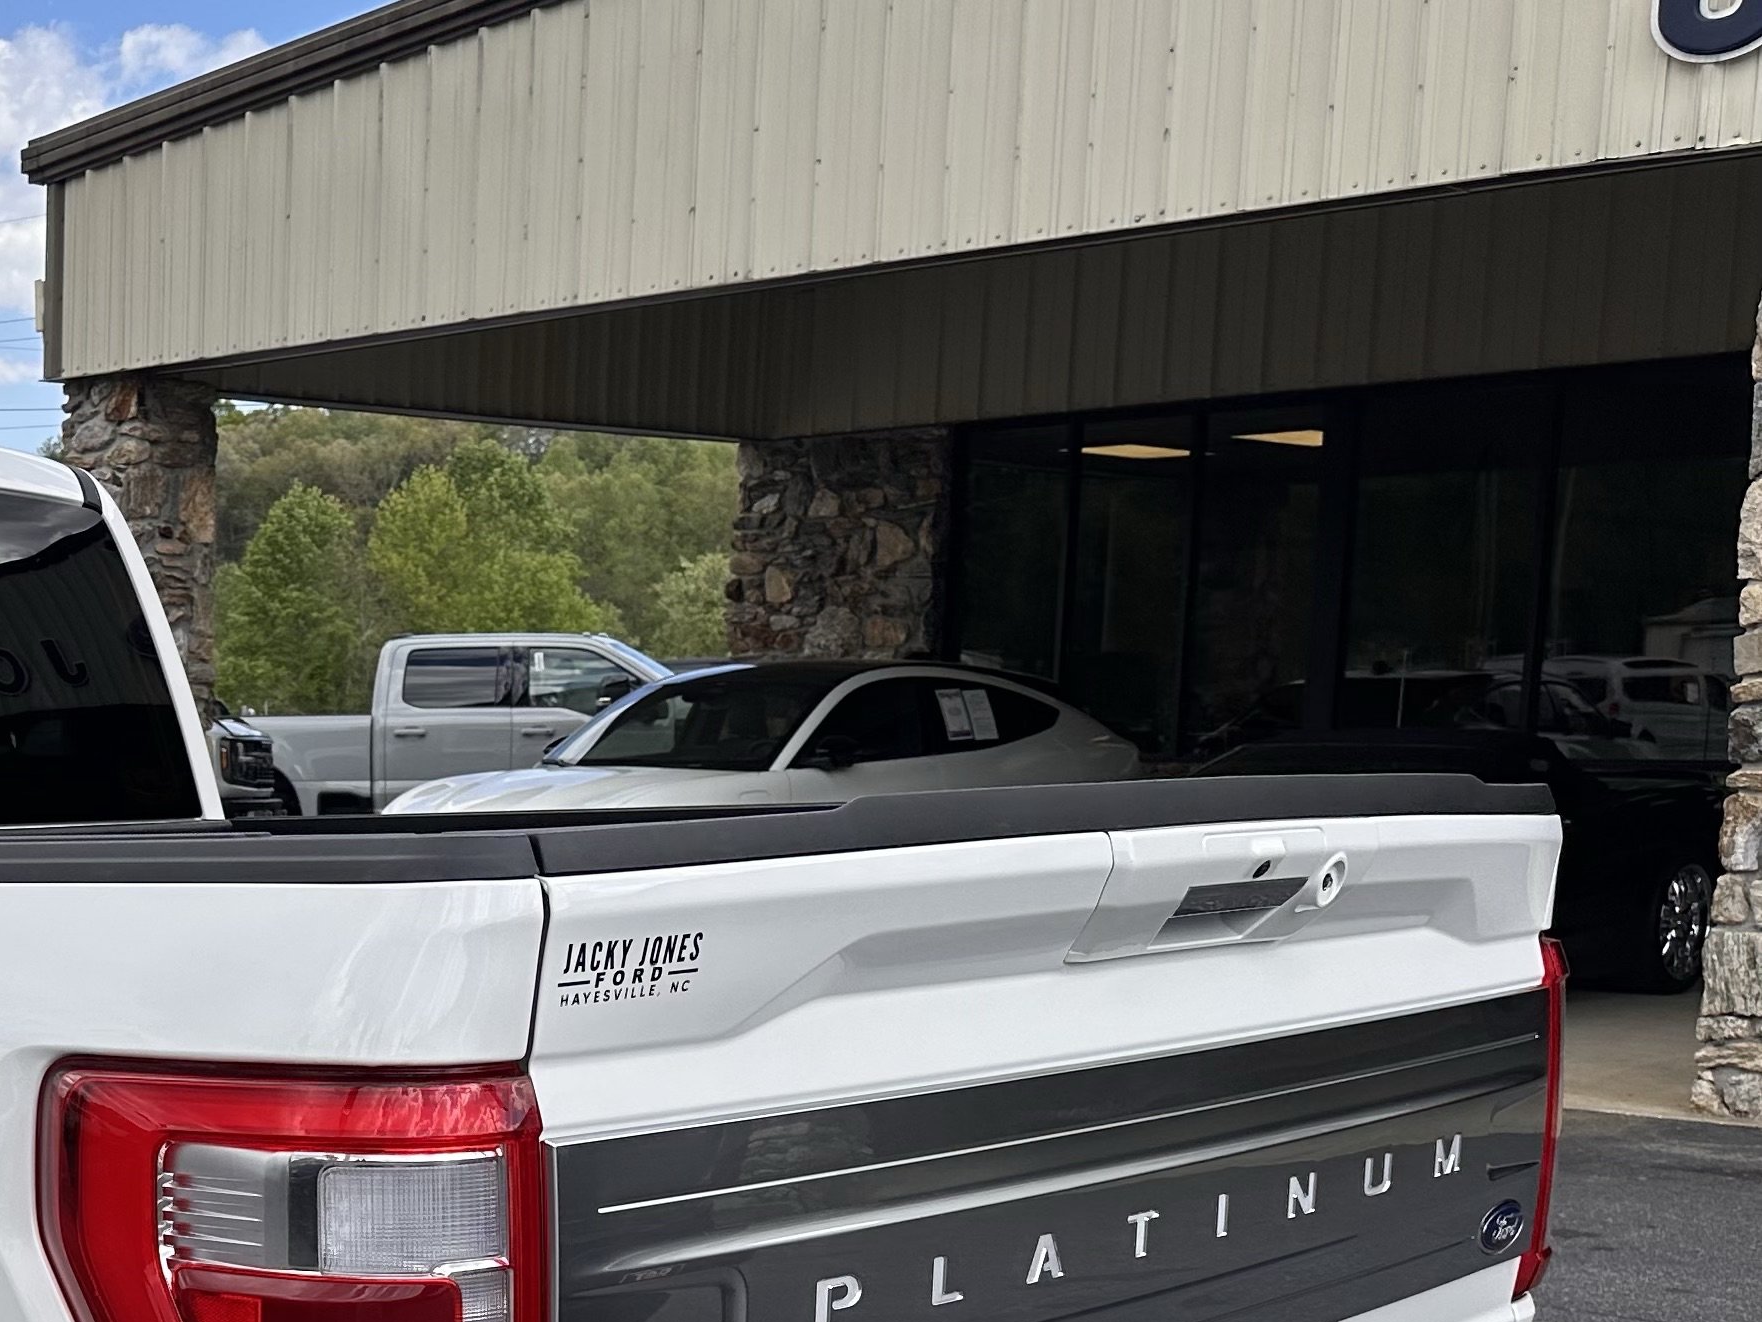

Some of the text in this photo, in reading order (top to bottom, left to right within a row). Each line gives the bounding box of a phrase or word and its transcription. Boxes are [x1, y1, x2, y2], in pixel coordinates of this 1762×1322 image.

[563, 931, 704, 975] JACKY JONES
[594, 966, 663, 988] FORD
[559, 979, 691, 1008] HAYESVILLE, NC
